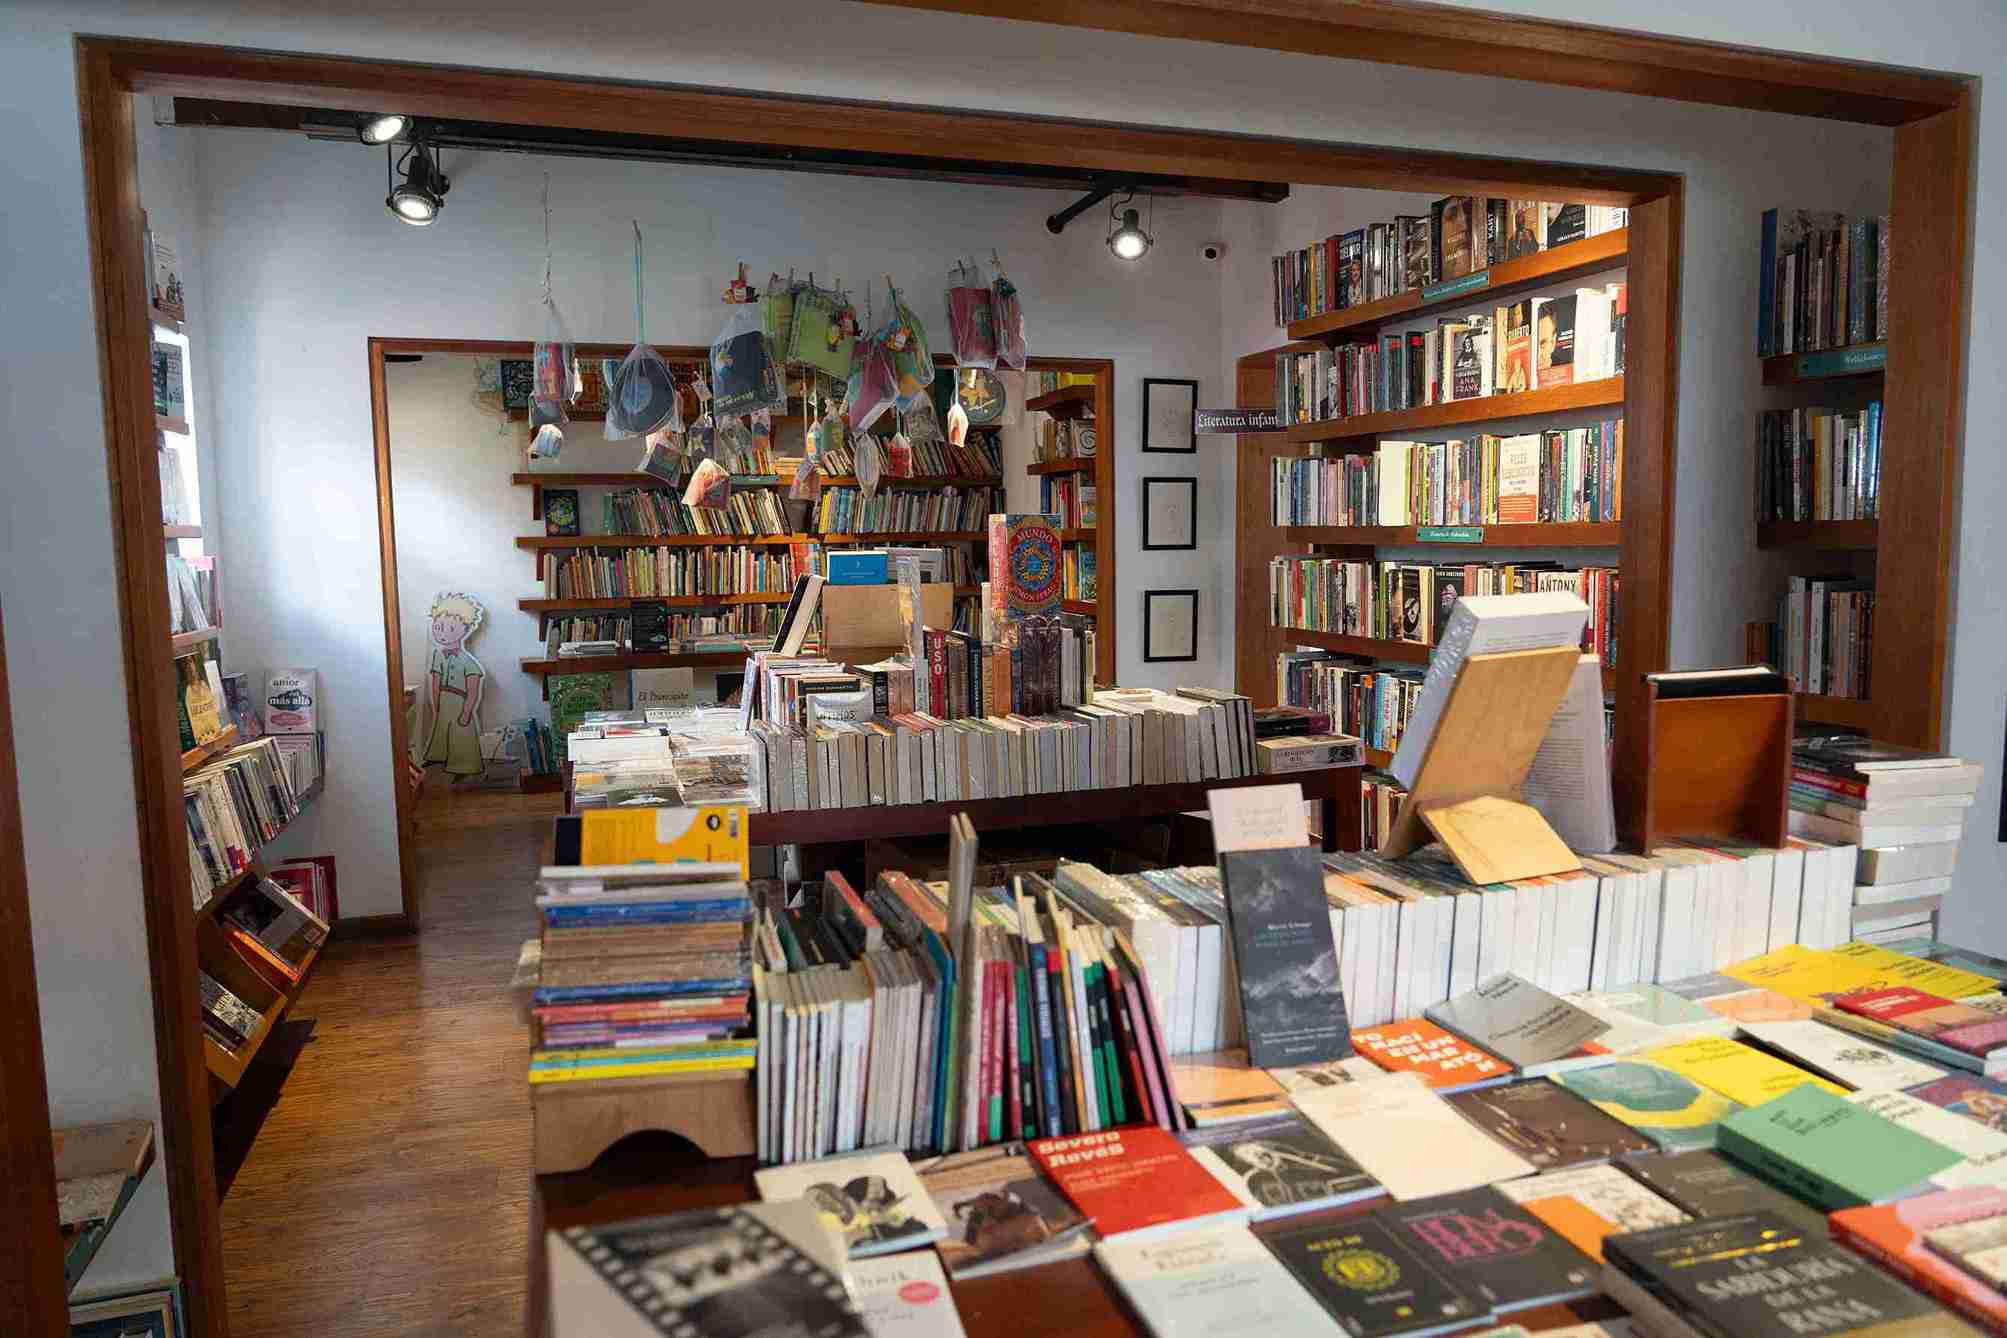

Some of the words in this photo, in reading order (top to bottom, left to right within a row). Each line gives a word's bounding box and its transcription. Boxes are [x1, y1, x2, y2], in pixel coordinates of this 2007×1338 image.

[1198, 414, 1248, 429] Literatura
[1017, 528, 1054, 544] MUNDO
[1539, 578, 1577, 593] ANTONY
[271, 679, 300, 688] amor
